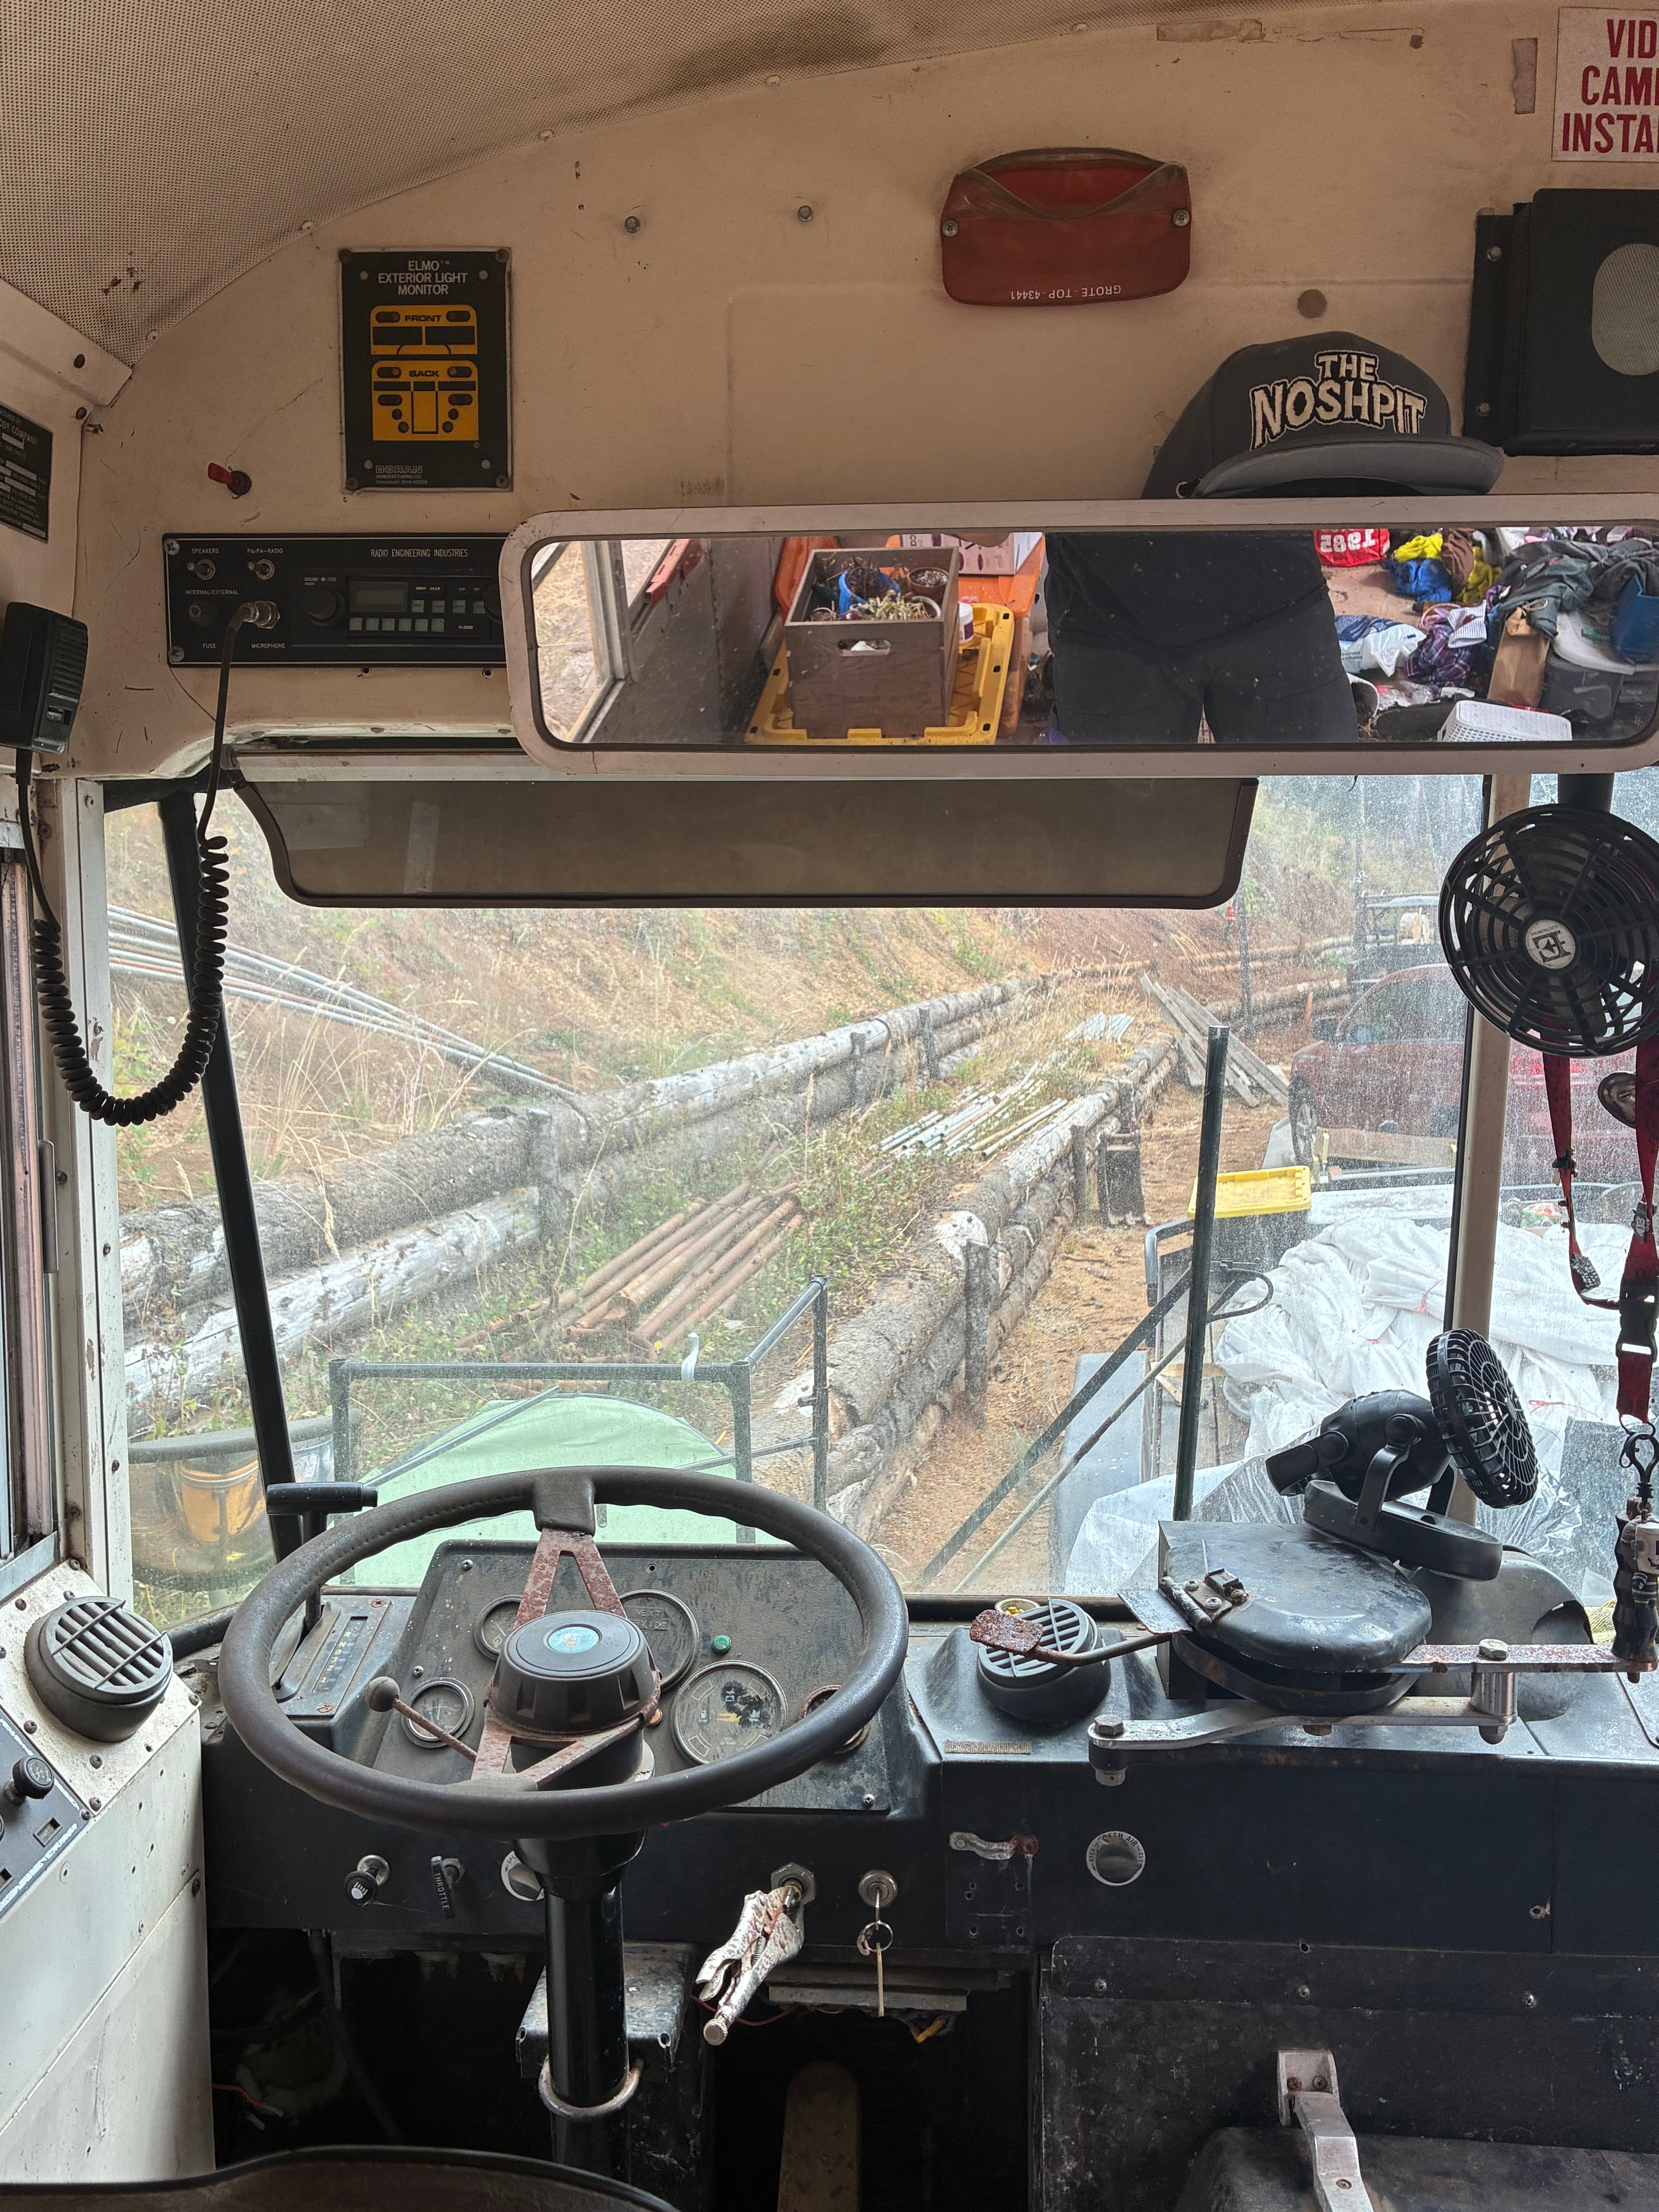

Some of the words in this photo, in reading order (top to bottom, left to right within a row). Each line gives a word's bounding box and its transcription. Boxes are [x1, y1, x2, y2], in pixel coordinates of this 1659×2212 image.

[1581, 65, 1659, 105] CAM
[1562, 112, 1659, 153] INSTA
[408, 260, 440, 271] ELMO
[378, 272, 431, 283] EXTERIOR
[435, 272, 468, 283] LIGHT
[397, 285, 449, 295] MONITOR
[1010, 290, 1040, 300] 43441
[1048, 288, 1072, 298] TOP
[1081, 285, 1121, 297] GROTE
[1316, 351, 1377, 380] THE
[1251, 377, 1426, 450] NOSHPIT
[375, 465, 423, 474] DORAN
[370, 549, 388, 558] RADIO
[392, 549, 431, 558] ENGINEERING
[434, 549, 468, 558] INDUSTRIES
[1126, 1836, 1138, 1847] AIR
[434, 1873, 450, 1910] THROTTLE
